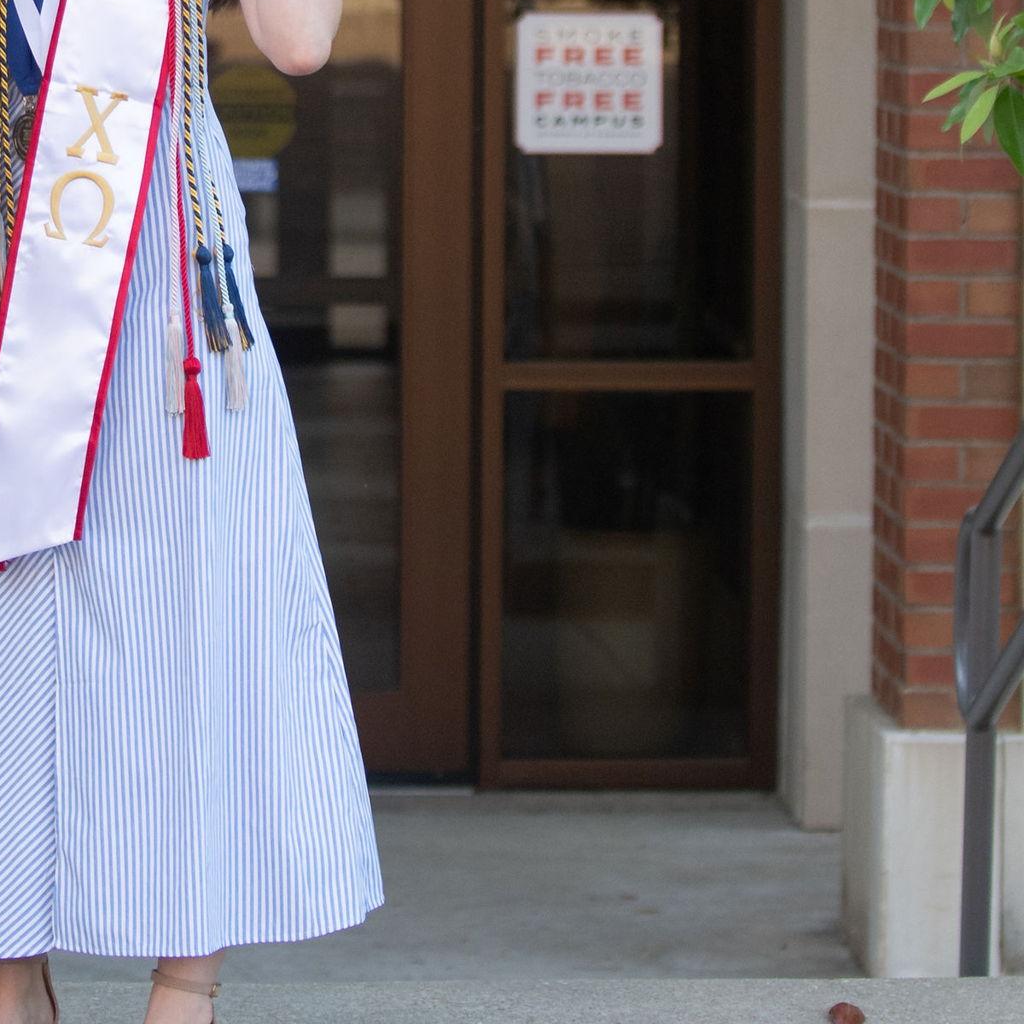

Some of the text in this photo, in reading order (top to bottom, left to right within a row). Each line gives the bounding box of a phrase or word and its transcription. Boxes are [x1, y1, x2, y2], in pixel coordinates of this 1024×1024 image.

[534, 46, 644, 66] FREE
[534, 90, 644, 111] FREE
[43, 170, 115, 248] Ω
